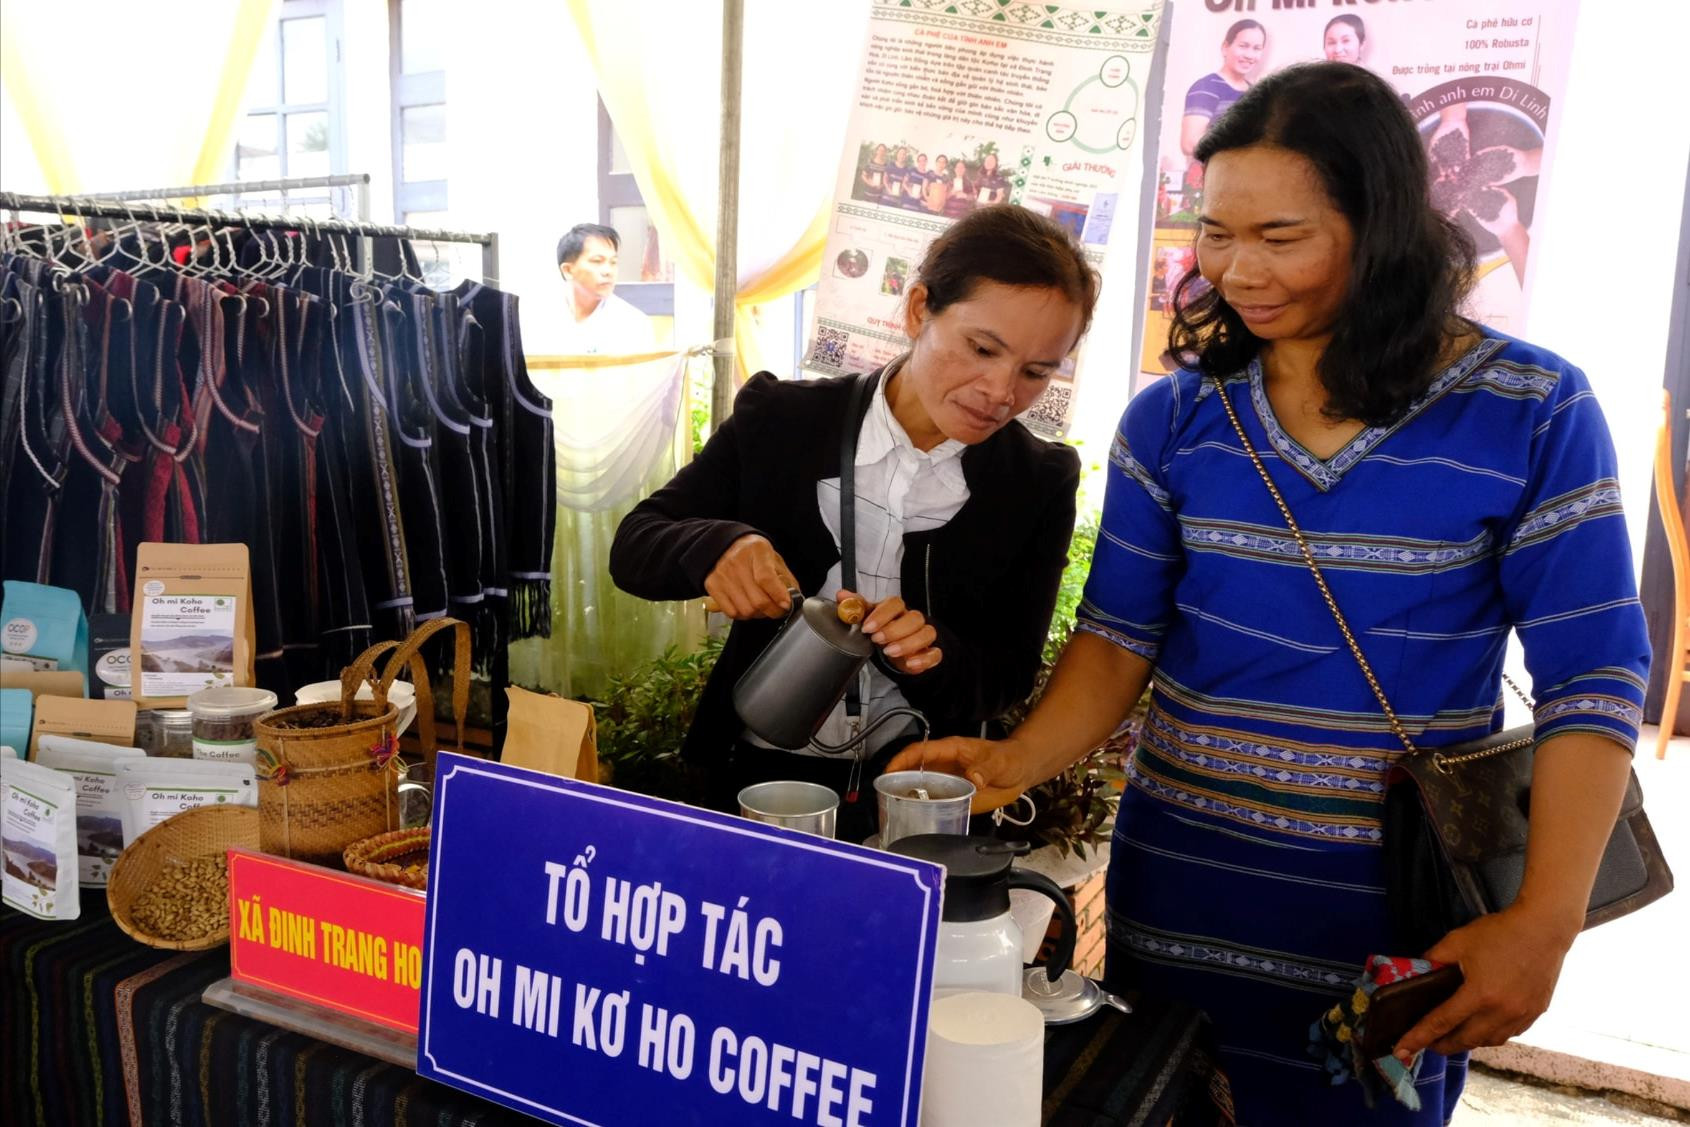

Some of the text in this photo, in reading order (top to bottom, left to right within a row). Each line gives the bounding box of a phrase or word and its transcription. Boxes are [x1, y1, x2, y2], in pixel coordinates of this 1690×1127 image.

[1465, 38, 1529, 50] 100% Robusta
[1439, 86, 1467, 105] anh
[1471, 86, 1495, 97] em
[1499, 86, 1520, 100] Di
[1519, 94, 1548, 120] Linh
[106, 655, 132, 664] OC
[82, 784, 110, 794] Coffee
[180, 794, 204, 802] Koho
[544, 844, 784, 987] TỔ HỢP TÁC
[238, 894, 422, 990] XÃ ĐINH TRANG HO
[453, 947, 878, 1127] OH MI KƠ HO COFFEE
